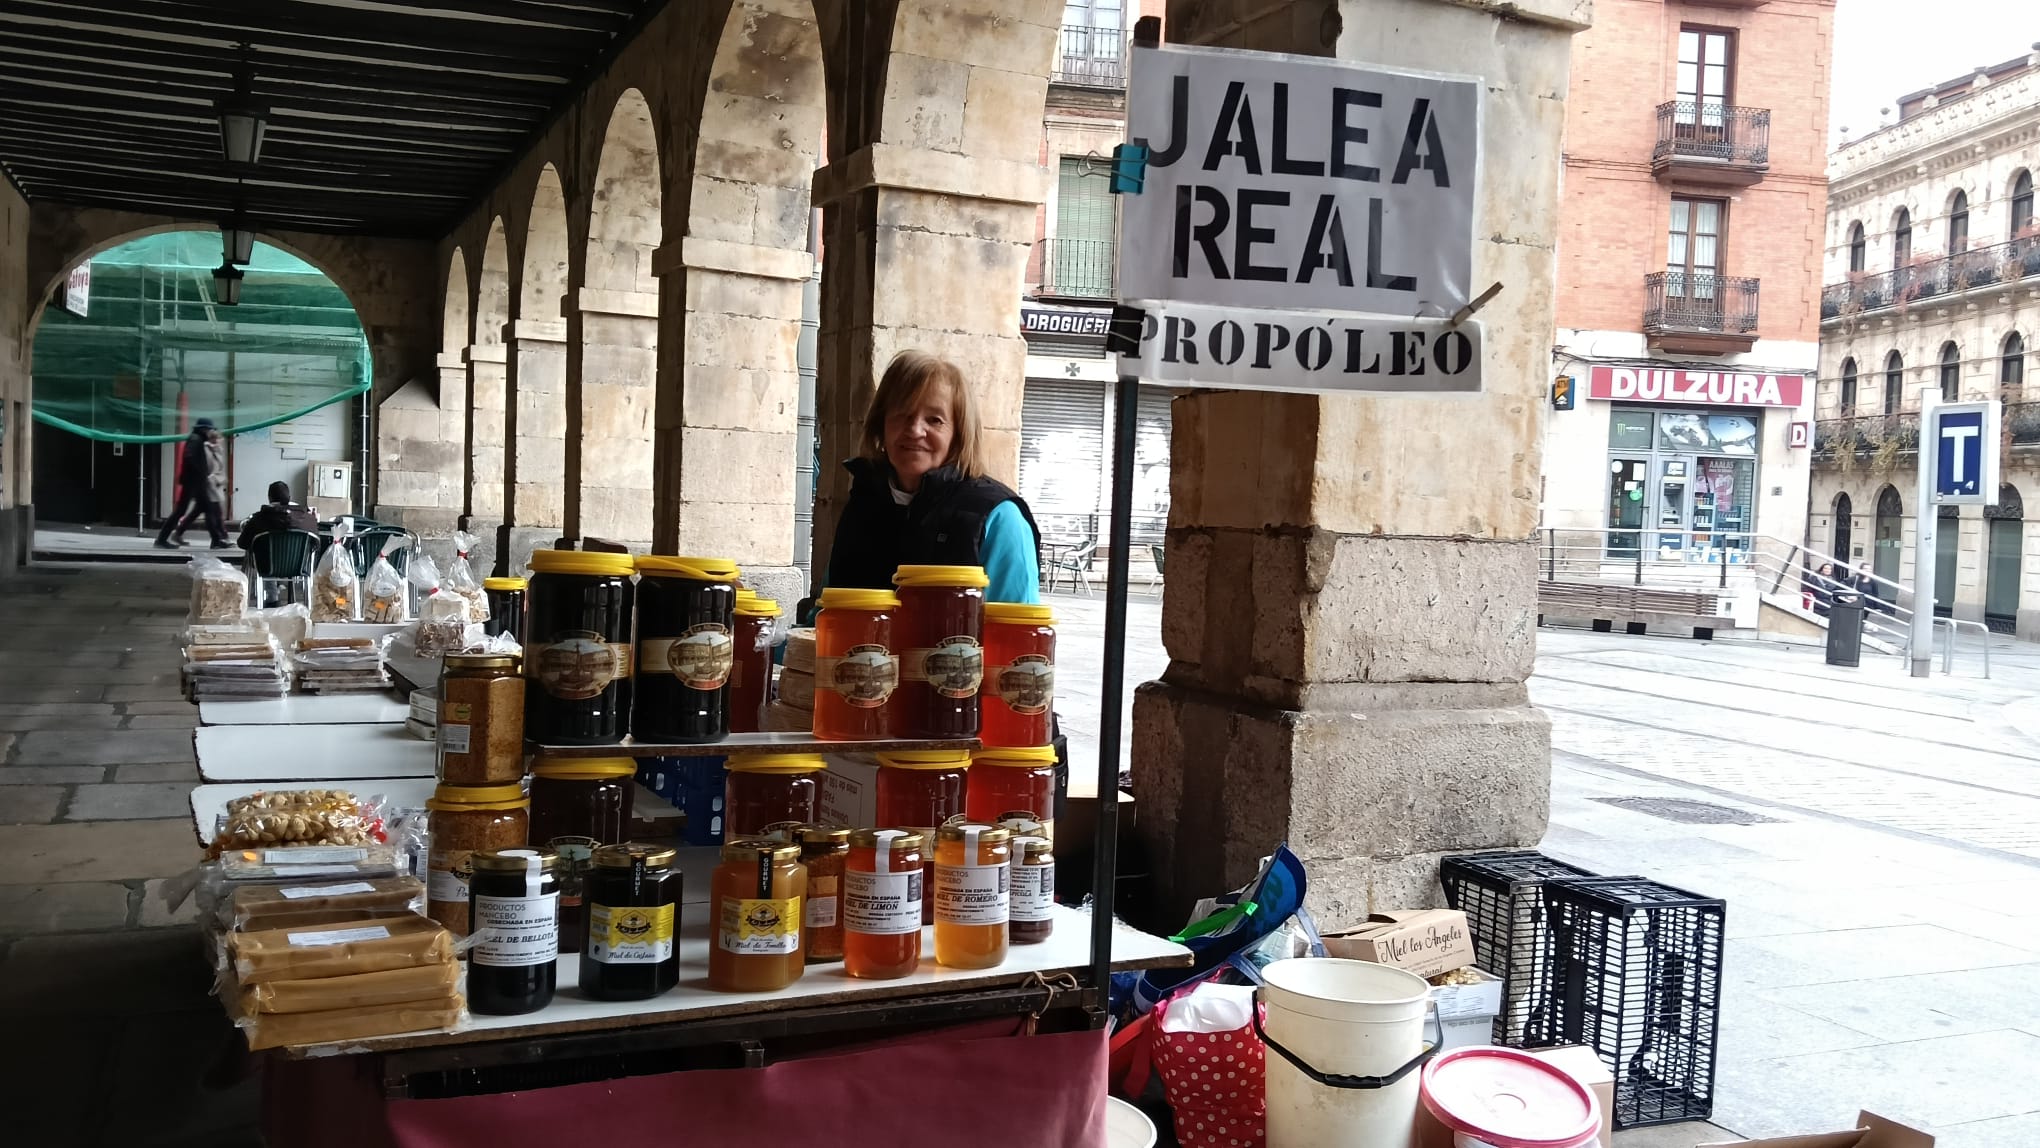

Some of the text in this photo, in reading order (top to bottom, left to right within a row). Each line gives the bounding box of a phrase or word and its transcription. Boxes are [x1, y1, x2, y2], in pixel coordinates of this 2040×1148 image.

[1133, 75, 1451, 188] JALEA
[1172, 184, 1418, 292] REAL
[1026, 313, 1111, 335] DROGUERI
[1121, 313, 1473, 376] PROPÓLEO
[1611, 368, 1783, 405] DULZURA
[1792, 425, 1806, 443] D
[1942, 425, 1979, 482] T
[480, 902, 526, 912] PRODUCTOS
[951, 895, 963, 903] DE
[964, 894, 999, 903] ROMERO
[480, 911, 517, 920] MANCEBO
[521, 932, 554, 943] BELLOTA
[1378, 925, 1462, 963] Miel los Angeles
